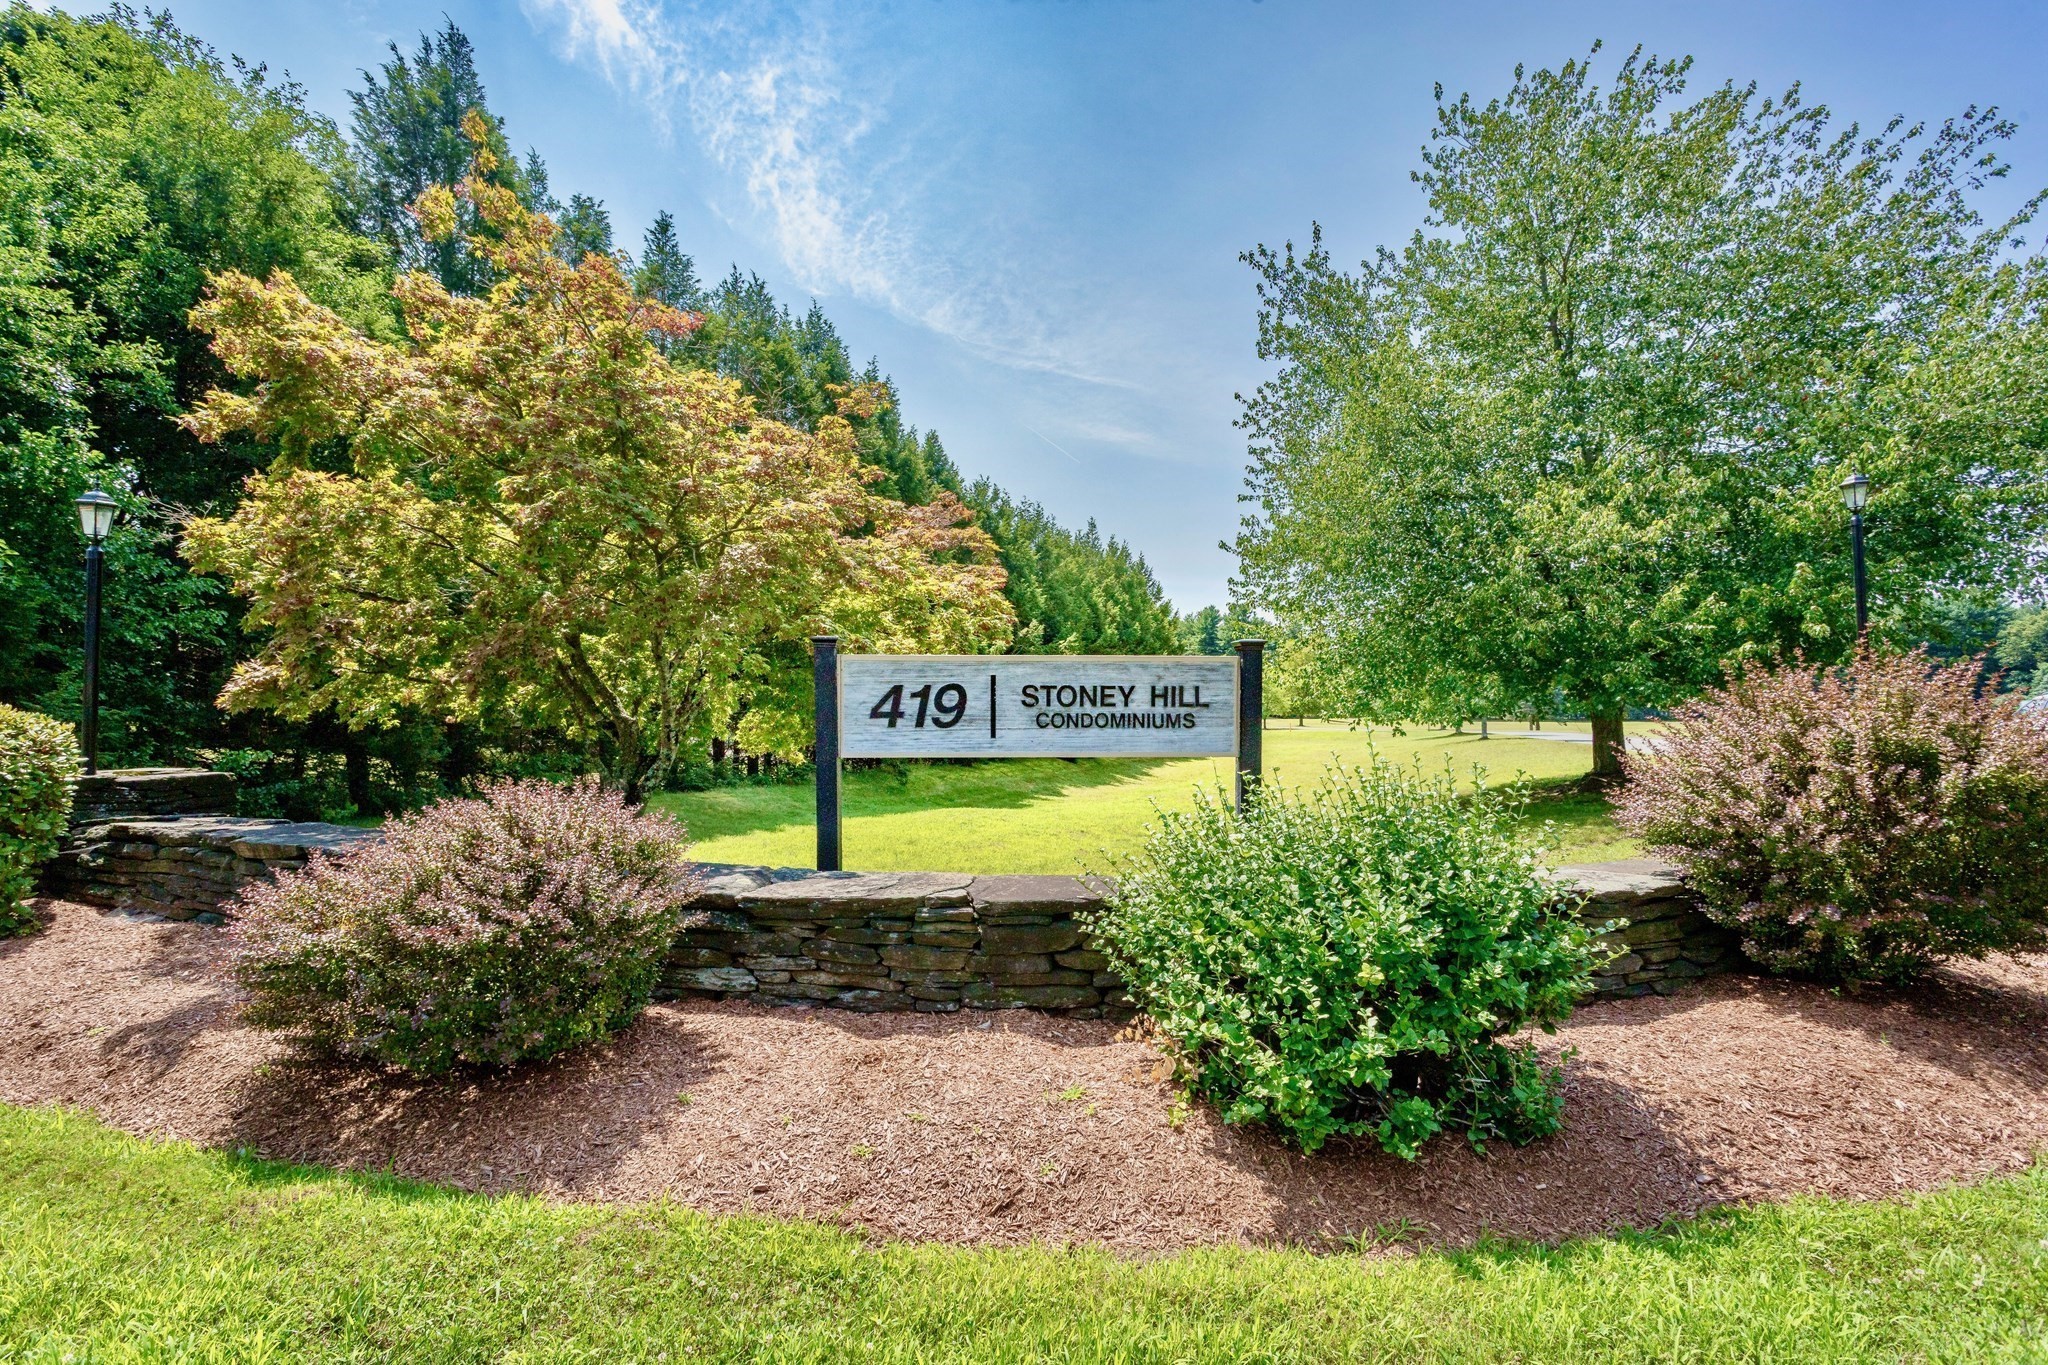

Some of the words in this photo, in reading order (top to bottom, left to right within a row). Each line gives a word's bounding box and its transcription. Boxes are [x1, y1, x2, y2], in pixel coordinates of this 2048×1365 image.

[869, 683, 967, 729] 419
[1020, 685, 1135, 708] STONEY
[1150, 685, 1209, 708] HILL
[1035, 712, 1196, 729] CONDOMINIUMS
